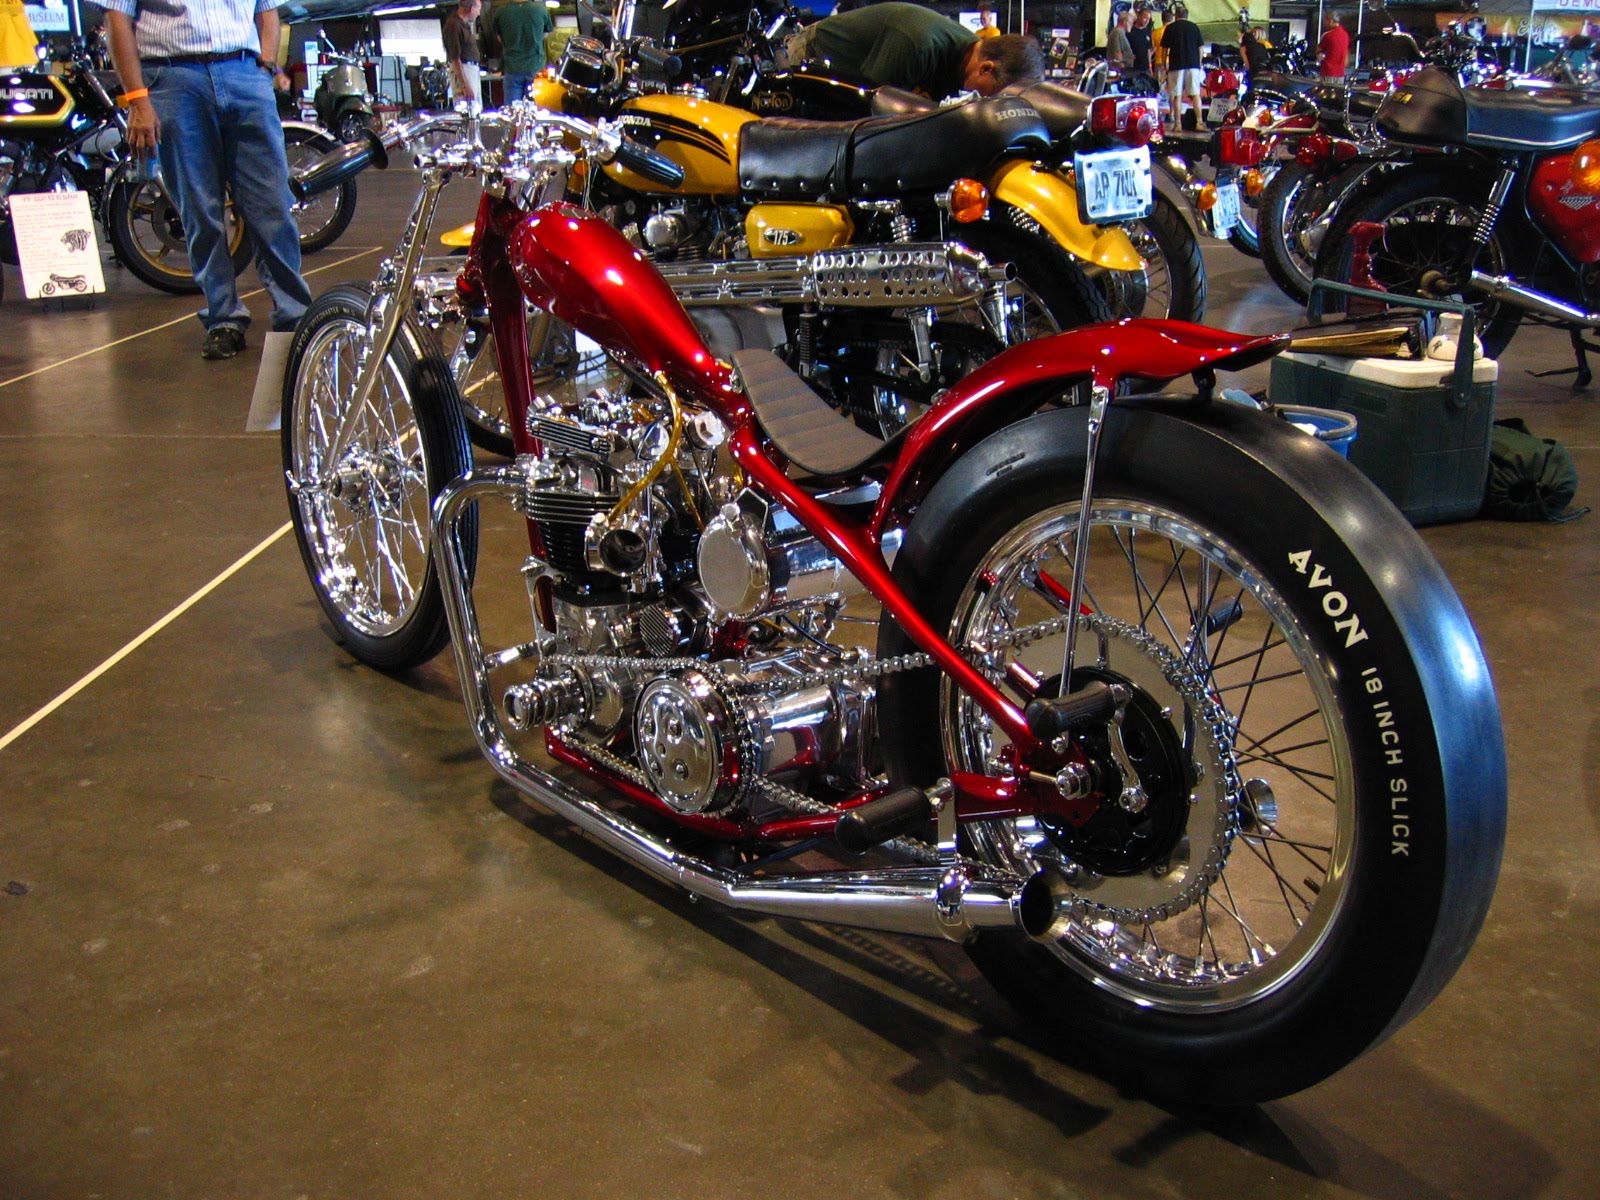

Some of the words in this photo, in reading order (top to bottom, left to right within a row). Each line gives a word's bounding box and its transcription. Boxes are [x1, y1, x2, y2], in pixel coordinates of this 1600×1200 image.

[0, 88, 53, 100] UCATI
[751, 91, 793, 111] Norton
[617, 114, 652, 127] HONDA
[994, 107, 1042, 121] HONDA
[773, 229, 789, 246] 175
[1288, 549, 1370, 649] AVON
[1361, 666, 1383, 694] 18
[1372, 701, 1404, 765] INCH
[1389, 778, 1411, 857] SLICK
